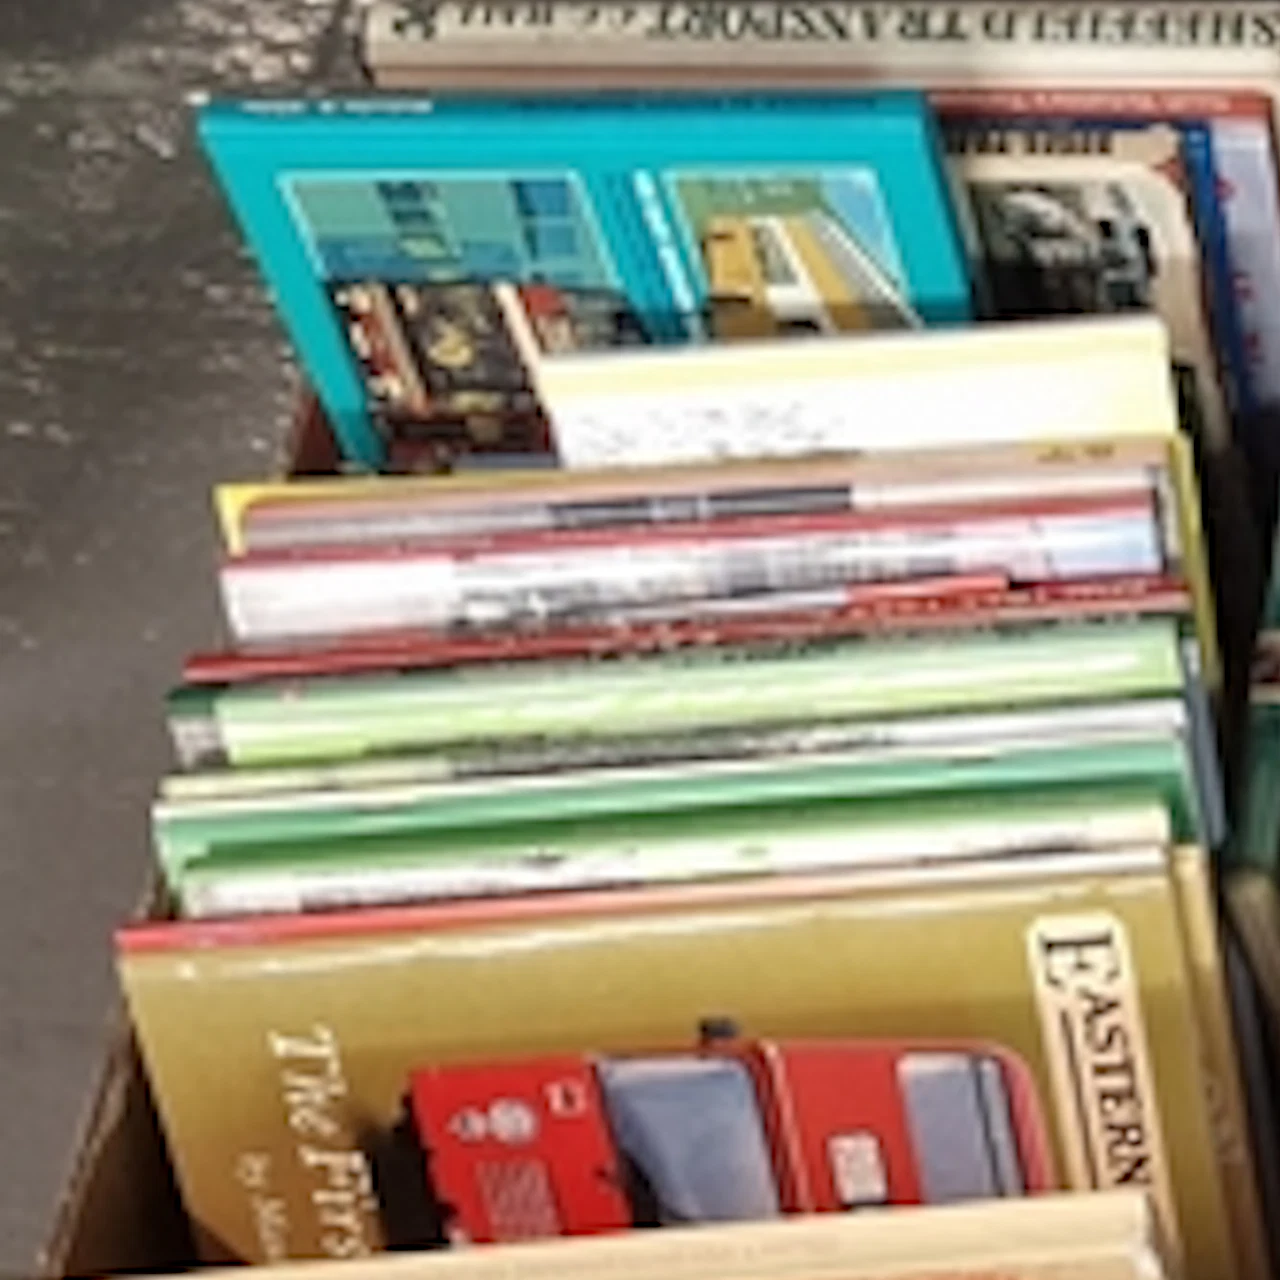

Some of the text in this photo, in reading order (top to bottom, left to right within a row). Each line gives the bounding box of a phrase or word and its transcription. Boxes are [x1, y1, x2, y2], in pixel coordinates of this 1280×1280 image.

[646, 4, 969, 44] TRANSPORT
[266, 1023, 348, 1139] The
[1039, 928, 1151, 1187] EASTERN
[298, 1144, 382, 1260] Firs
